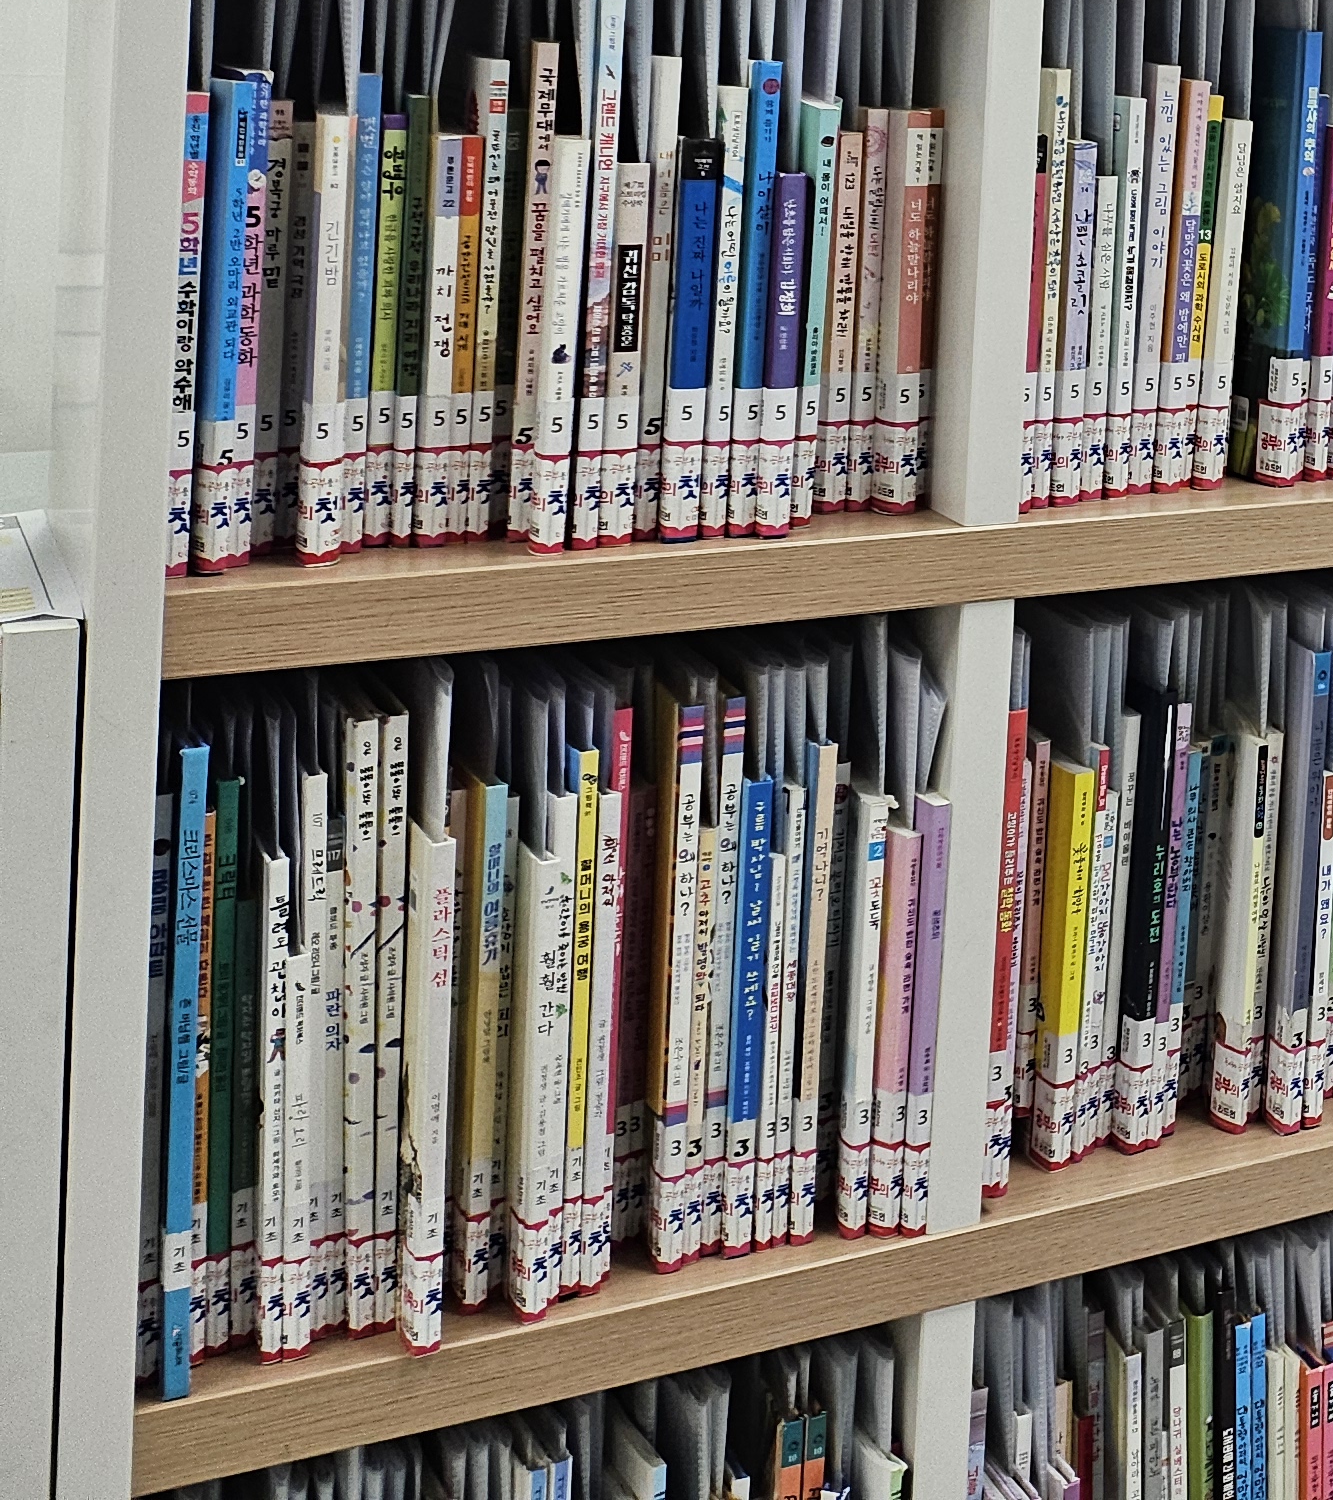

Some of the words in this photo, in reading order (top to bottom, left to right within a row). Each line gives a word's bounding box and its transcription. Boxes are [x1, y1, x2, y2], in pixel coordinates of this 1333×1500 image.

[1158, 90, 1175, 122] 느낌
[1157, 133, 1172, 173] 있는
[267, 157, 287, 219] 경복궁
[1153, 182, 1169, 216] 그림
[531, 202, 550, 243] 꿈을
[693, 201, 709, 230] 나는
[840, 206, 856, 240] 내일을
[1073, 209, 1093, 248] 나쁜
[176, 210, 201, 276] 5학년
[264, 225, 282, 261] 마루
[323, 220, 340, 287] 긴긴밤
[1151, 228, 1164, 269] 이야기
[1198, 229, 1213, 242] 13
[622, 249, 642, 278] 귀신
[435, 265, 455, 302] 까치
[621, 280, 640, 312] 감독
[777, 278, 797, 316] 김정희
[175, 280, 197, 354] 수학이랑
[432, 312, 452, 359] 전쟁
[550, 416, 563, 434] 5
[1261, 432, 1287, 452] 공부의
[680, 793, 696, 844] 공부는
[722, 783, 738, 834] 공부는
[873, 845, 883, 858] 2
[578, 858, 594, 915] 할머니의
[679, 871, 695, 918] 하나?
[721, 861, 736, 905] 하나?
[1320, 863, 1333, 892] 내가
[432, 886, 451, 964] 플라스틱
[429, 969, 449, 989] 섬
[326, 987, 341, 1018] 파란
[325, 1024, 341, 1051] 의자
[670, 1139, 682, 1157] 3
[426, 1210, 441, 1243] 기초
